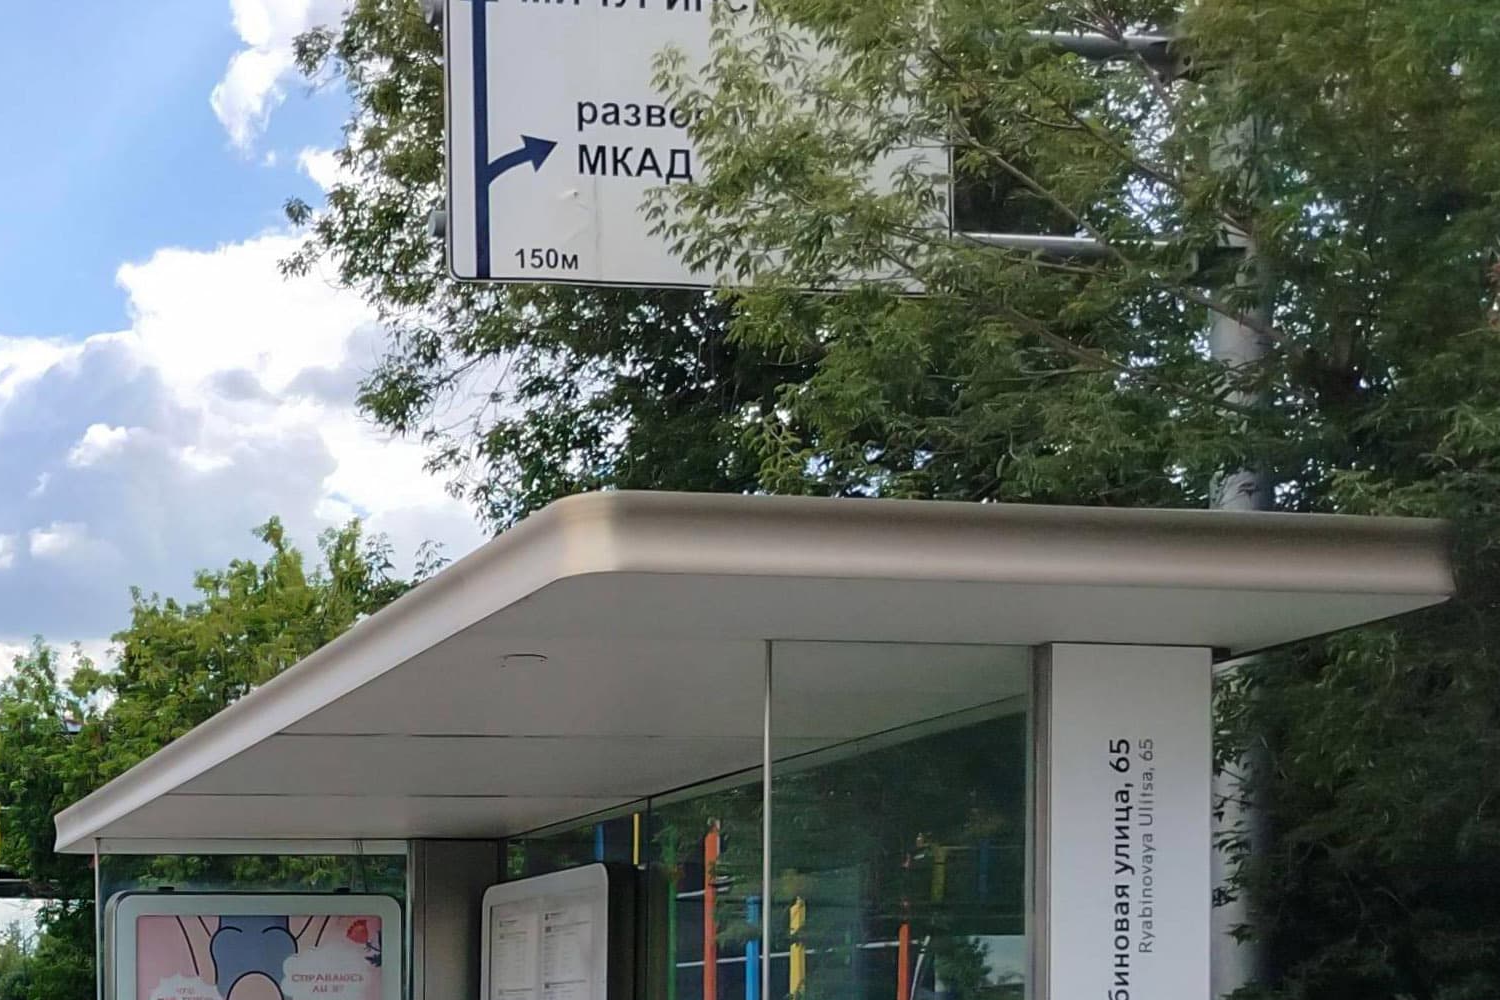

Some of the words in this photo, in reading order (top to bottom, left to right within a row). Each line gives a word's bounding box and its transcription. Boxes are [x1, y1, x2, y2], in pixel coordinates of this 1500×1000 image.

[577, 143, 693, 185] МКАД
[514, 248, 579, 270] 150м
[1108, 738, 1131, 774] 65
[1138, 738, 1154, 762] 65
[1114, 782, 1135, 876] улица,
[1137, 832, 1156, 953] Ryabinovaya
